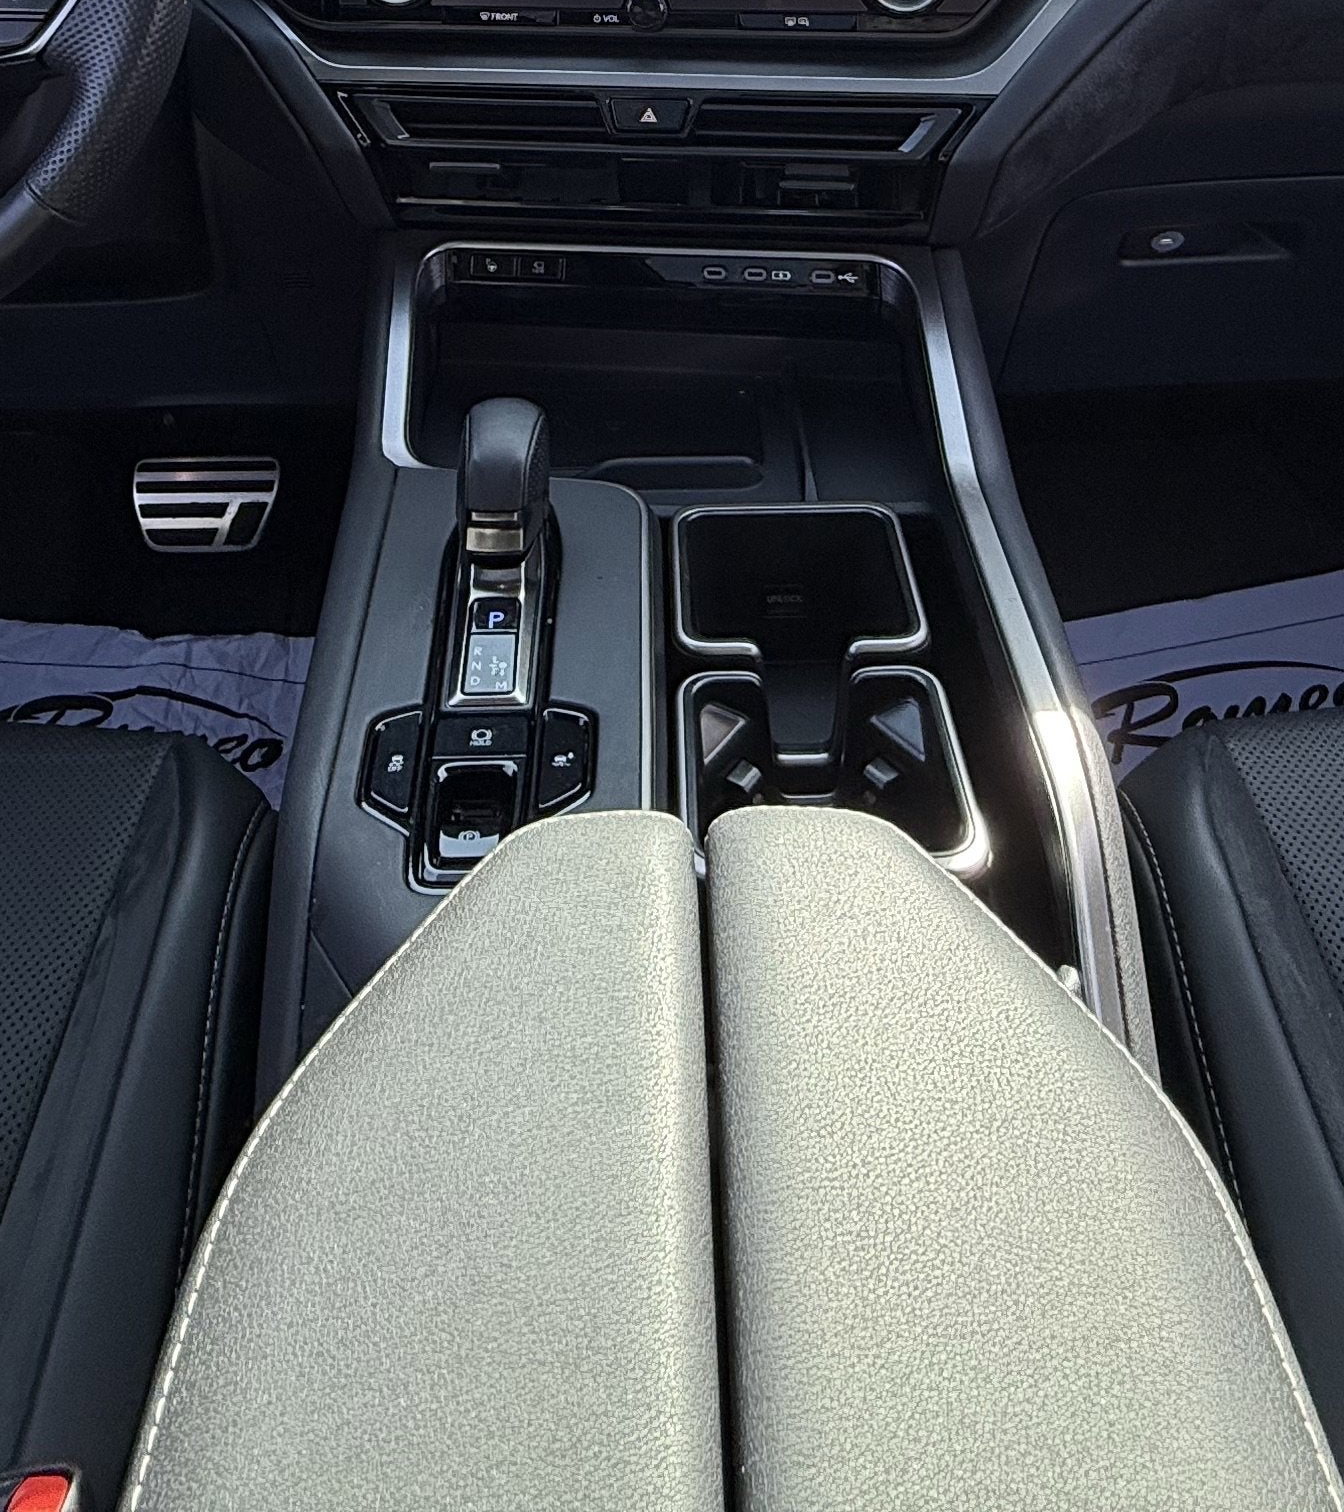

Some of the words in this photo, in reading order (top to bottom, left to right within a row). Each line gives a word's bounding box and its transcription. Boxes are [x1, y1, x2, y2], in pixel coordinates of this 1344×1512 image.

[490, 13, 519, 21] FRONT
[602, 15, 620, 23] VOL
[488, 611, 505, 629] P
[473, 646, 483, 656] R
[471, 661, 482, 671] N
[470, 676, 481, 686] D
[495, 681, 508, 691] M
